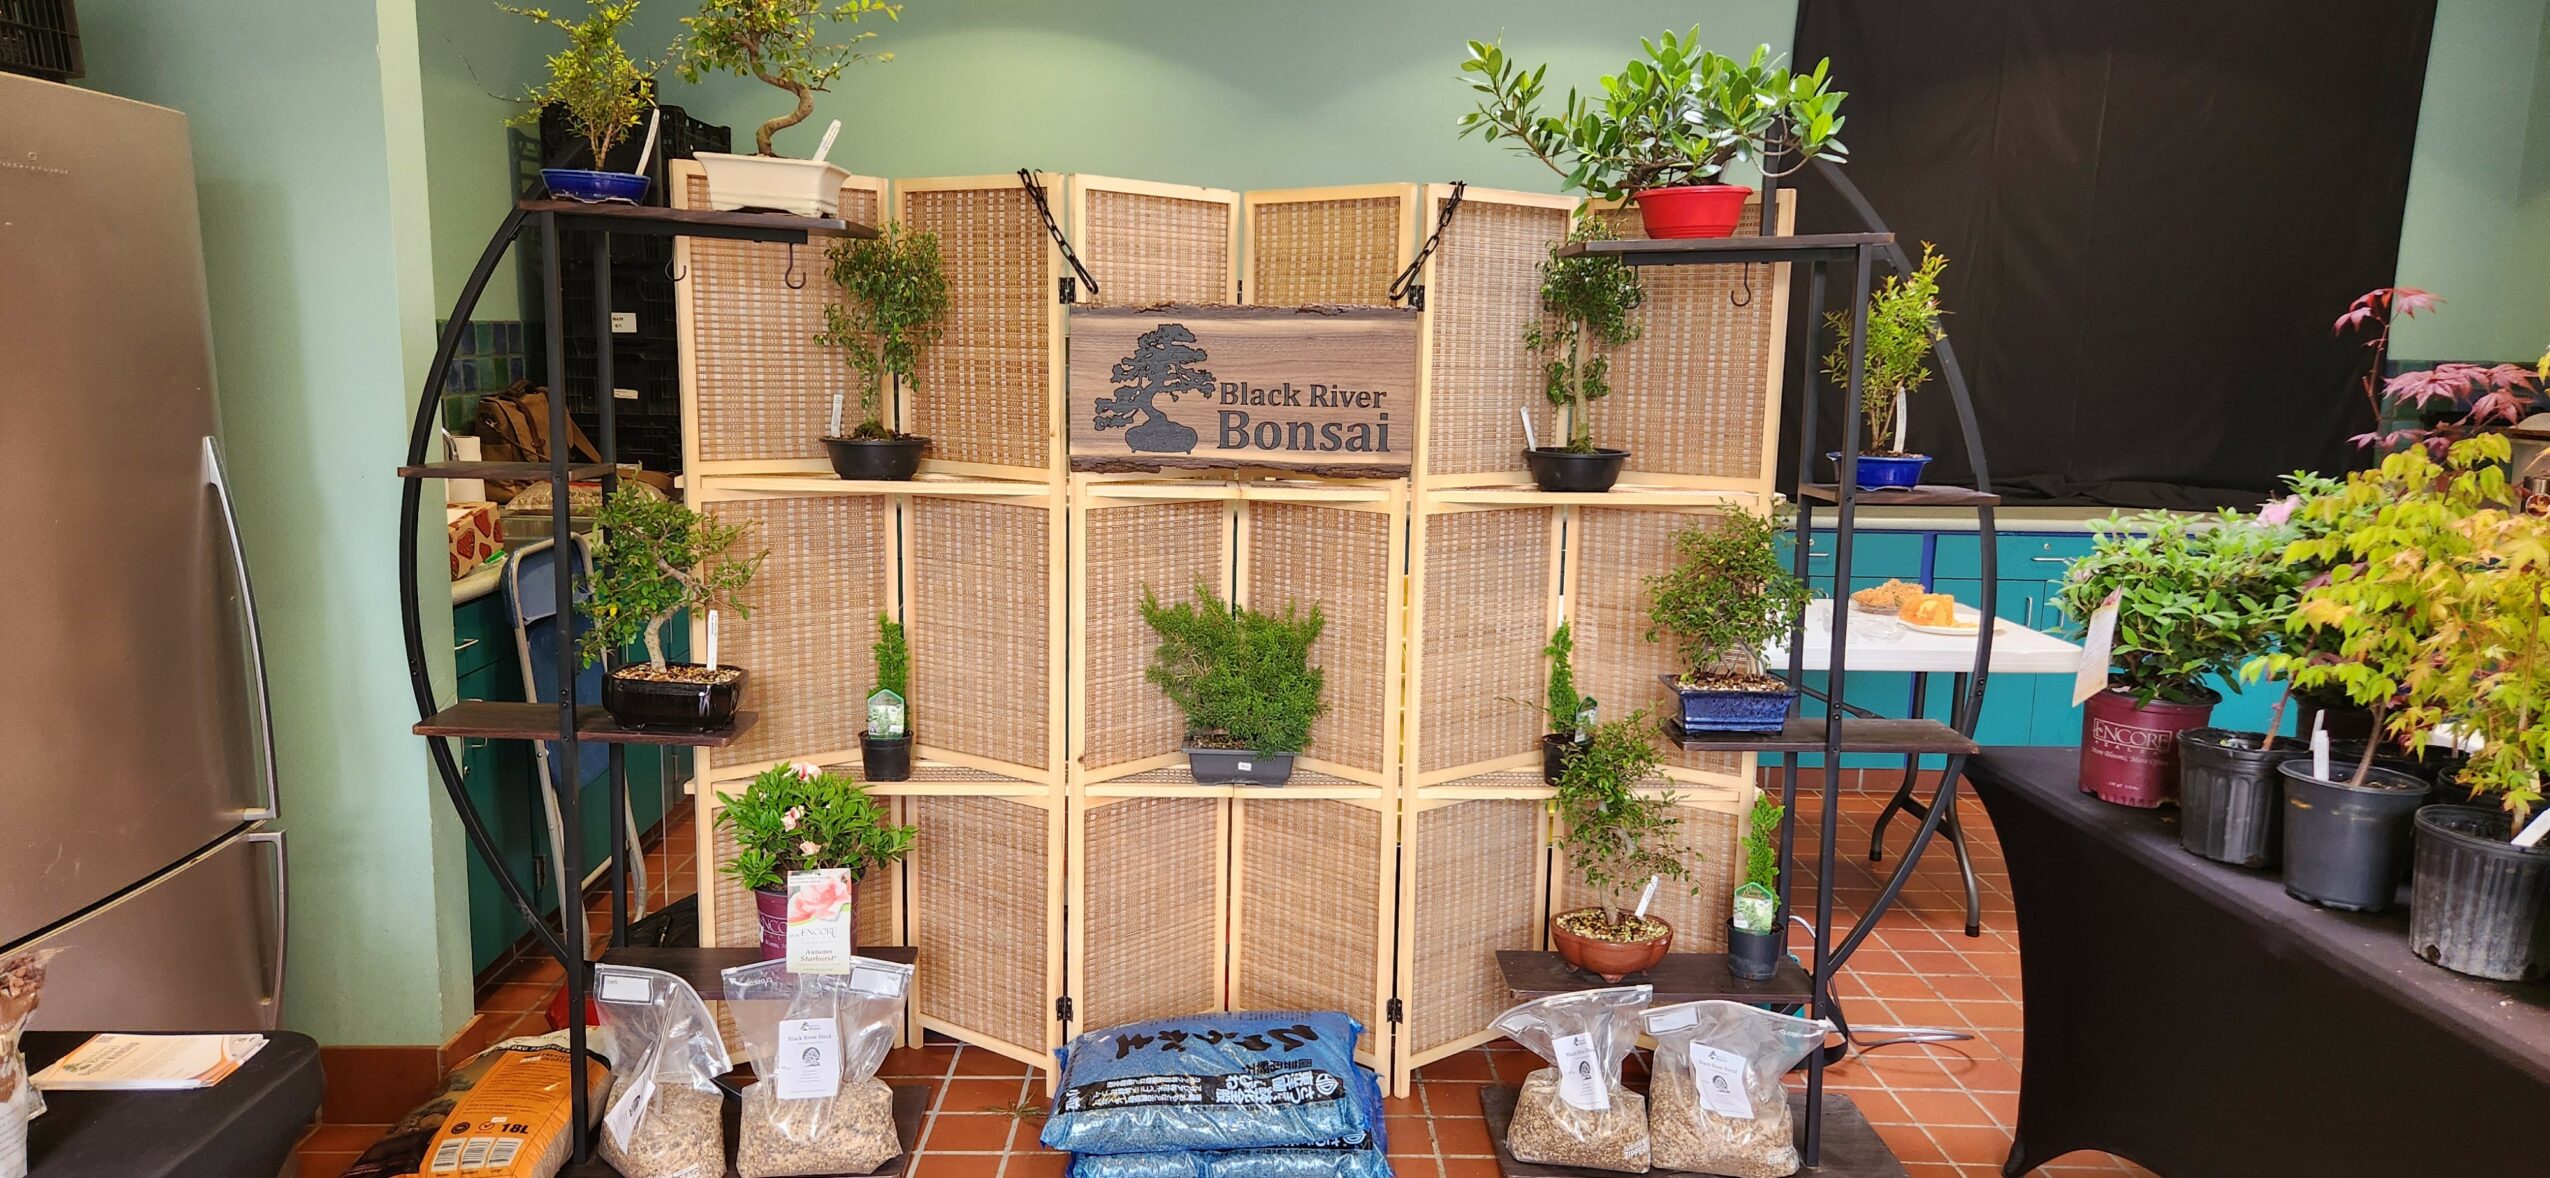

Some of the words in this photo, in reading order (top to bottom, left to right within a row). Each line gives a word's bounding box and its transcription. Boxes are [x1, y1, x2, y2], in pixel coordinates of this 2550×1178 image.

[1219, 382, 1301, 407] Black
[1309, 384, 1387, 409] River
[1217, 410, 1390, 452] Bonsai
[2093, 721, 2169, 749] ENCORE
[501, 1123, 529, 1135] 18L
